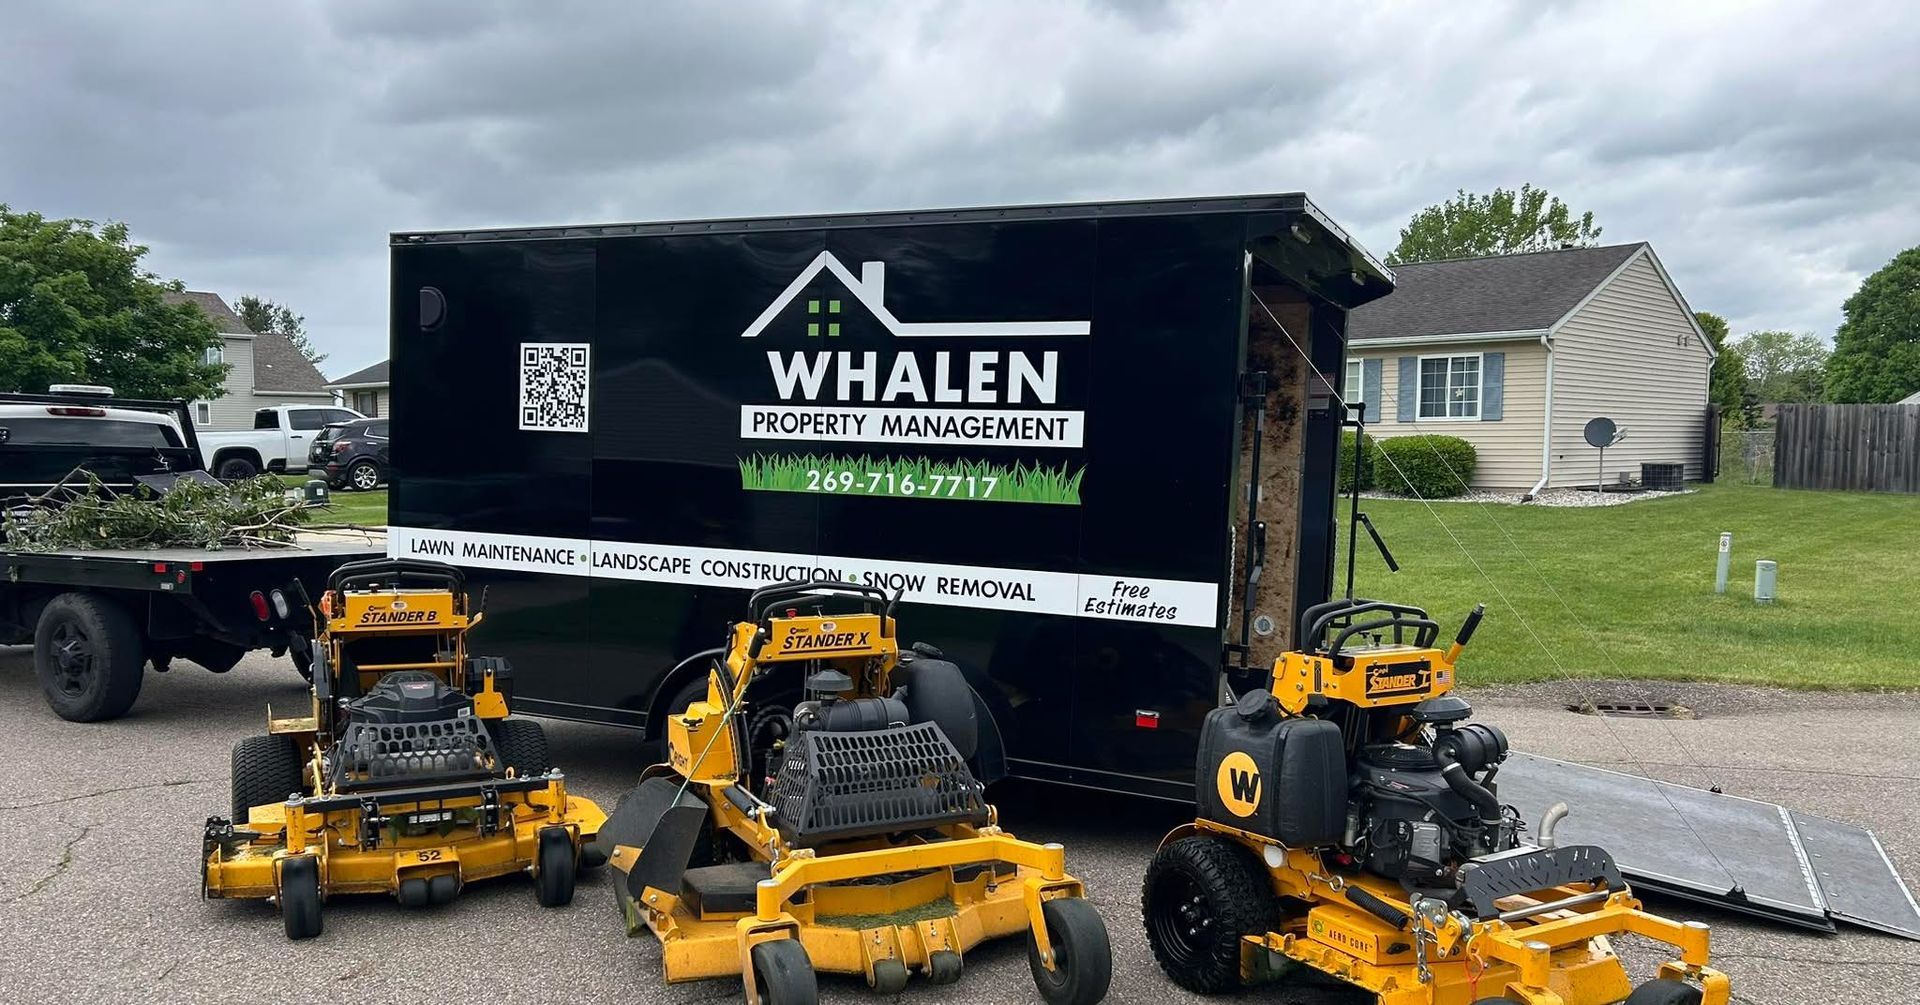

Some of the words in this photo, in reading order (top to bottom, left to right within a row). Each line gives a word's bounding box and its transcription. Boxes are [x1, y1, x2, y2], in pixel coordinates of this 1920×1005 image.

[767, 351, 1059, 404] WHALEN
[753, 411, 868, 436] PROPERTY
[881, 414, 1070, 441] MANAGEMENT
[806, 469, 999, 498] 269-716-7717
[411, 538, 455, 556] LAWN
[462, 542, 575, 566] MAINTENANCE
[592, 551, 692, 575] LANDSCAPE
[701, 559, 842, 583] CONSTRUCTION
[863, 571, 926, 593] SNOW
[937, 577, 1036, 602] REMOVAL
[1112, 580, 1150, 599] Free
[361, 611, 425, 624] STANDER
[427, 610, 437, 622] B
[1084, 597, 1178, 621] Estimates
[783, 632, 855, 650] STANDER
[857, 631, 870, 646] X
[1369, 674, 1417, 692] STANDER
[1229, 767, 1260, 805] W
[419, 850, 442, 862] 52
[1328, 929, 1347, 944] AERO
